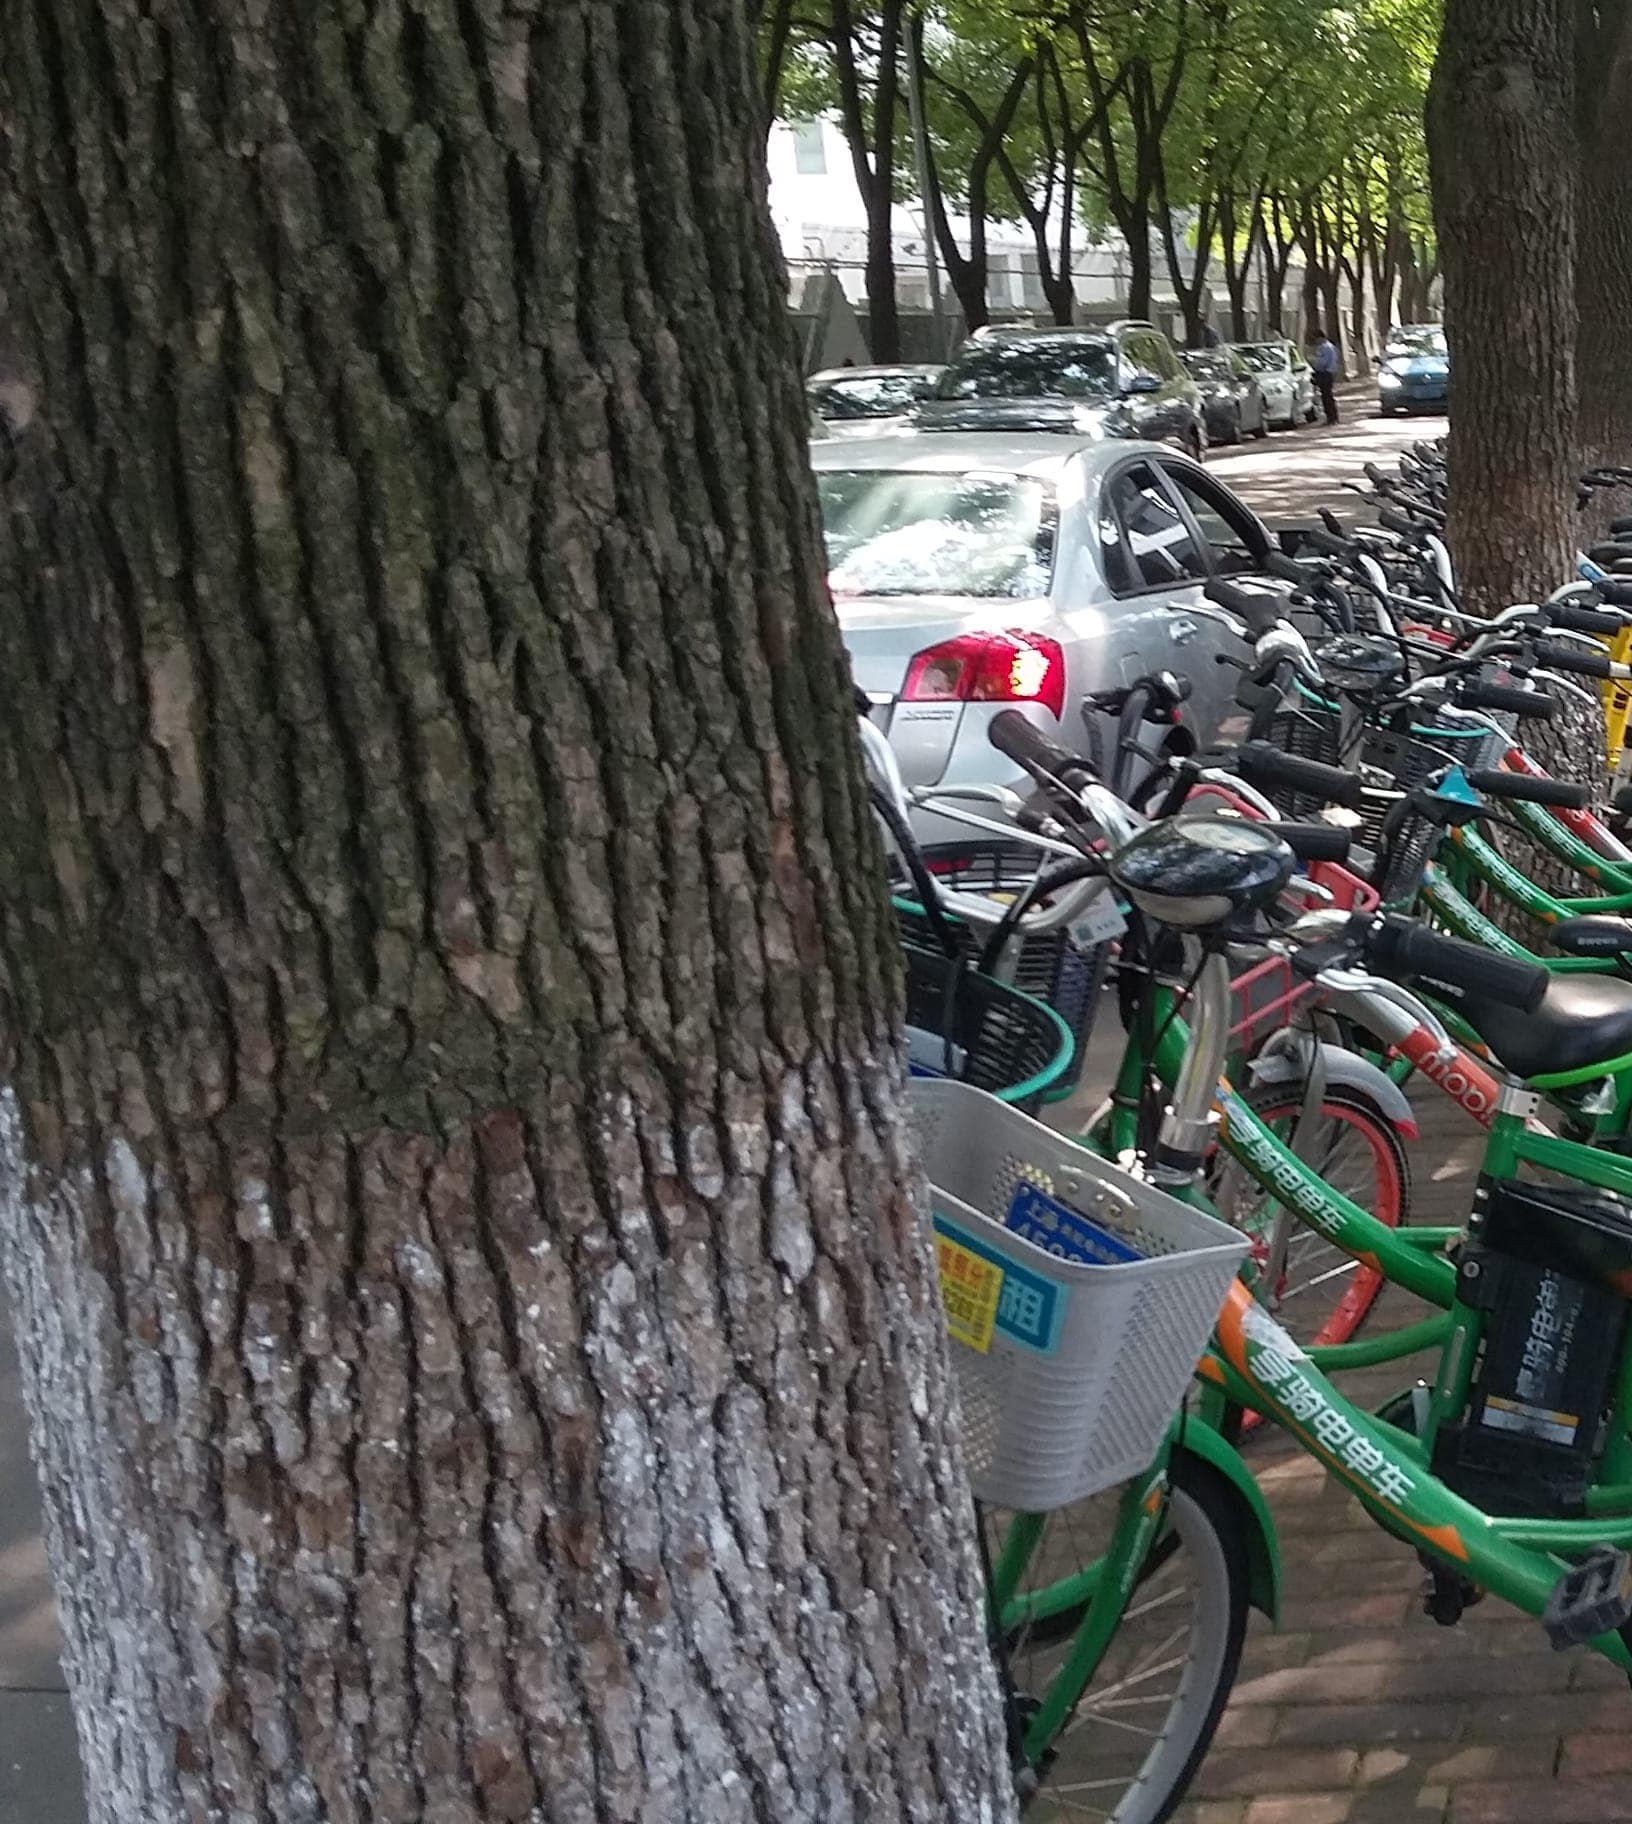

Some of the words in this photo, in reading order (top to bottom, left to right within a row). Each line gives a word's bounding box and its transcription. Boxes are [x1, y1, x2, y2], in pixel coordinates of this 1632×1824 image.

[1250, 1348, 1416, 1505] 享骑电单车
